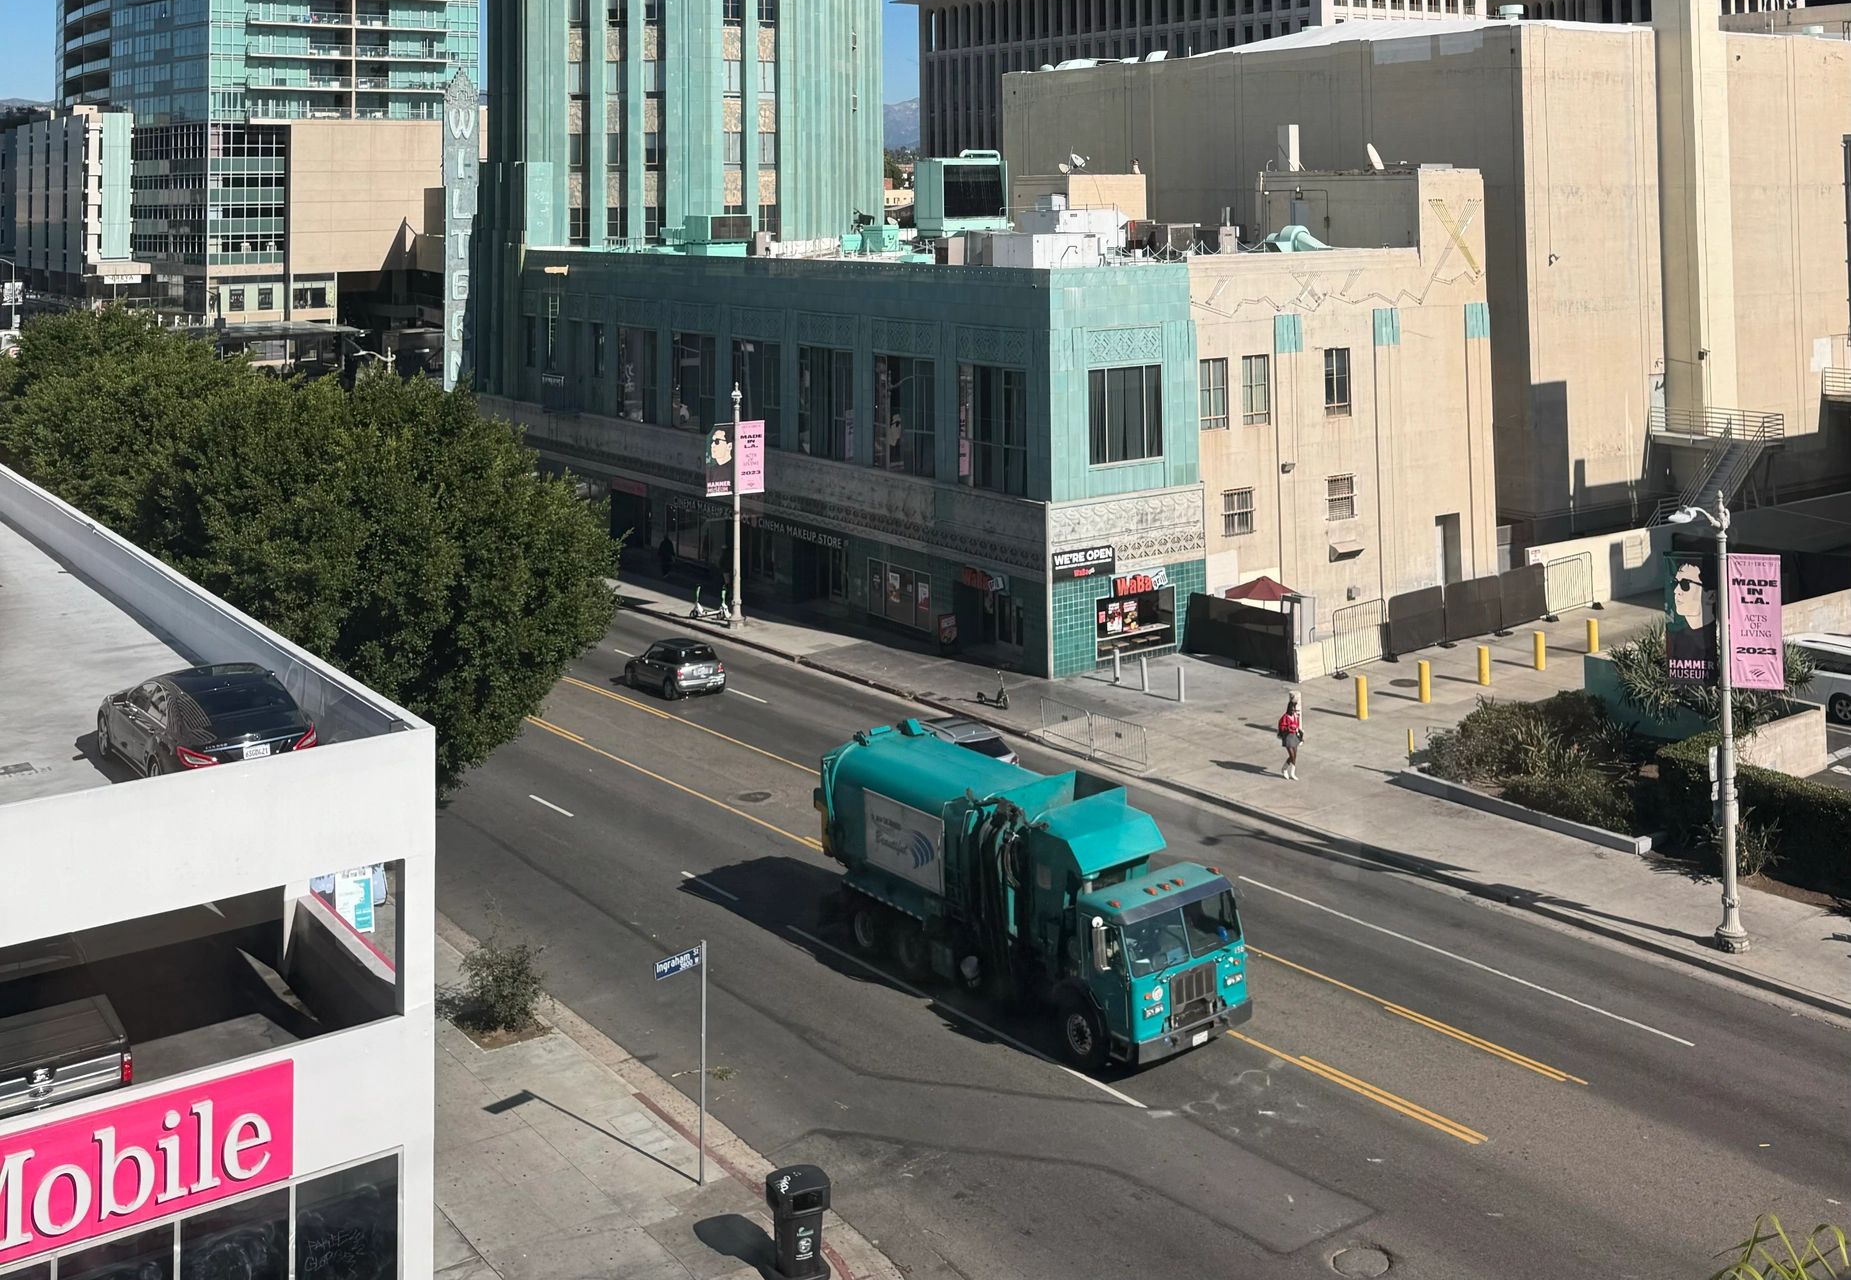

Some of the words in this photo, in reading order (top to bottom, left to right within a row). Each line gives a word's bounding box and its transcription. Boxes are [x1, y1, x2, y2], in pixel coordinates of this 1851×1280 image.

[448, 108, 475, 382] WILTERN
[758, 517, 785, 534] CINEMA
[786, 524, 817, 543] MAKEUP
[818, 534, 843, 550] STORE
[1054, 552, 1085, 566] WE'RE
[1086, 547, 1113, 561] OPEN
[1116, 574, 1152, 597] WaBa
[1732, 578, 1778, 587] MADE
[1741, 597, 1770, 605] L.A.
[1740, 630, 1772, 638] LIVING
[1736, 647, 1777, 656] 2023
[1669, 660, 1715, 670] HAMMER
[1669, 669, 1710, 679] MUSEUM
[656, 953, 691, 973] Ingraham
